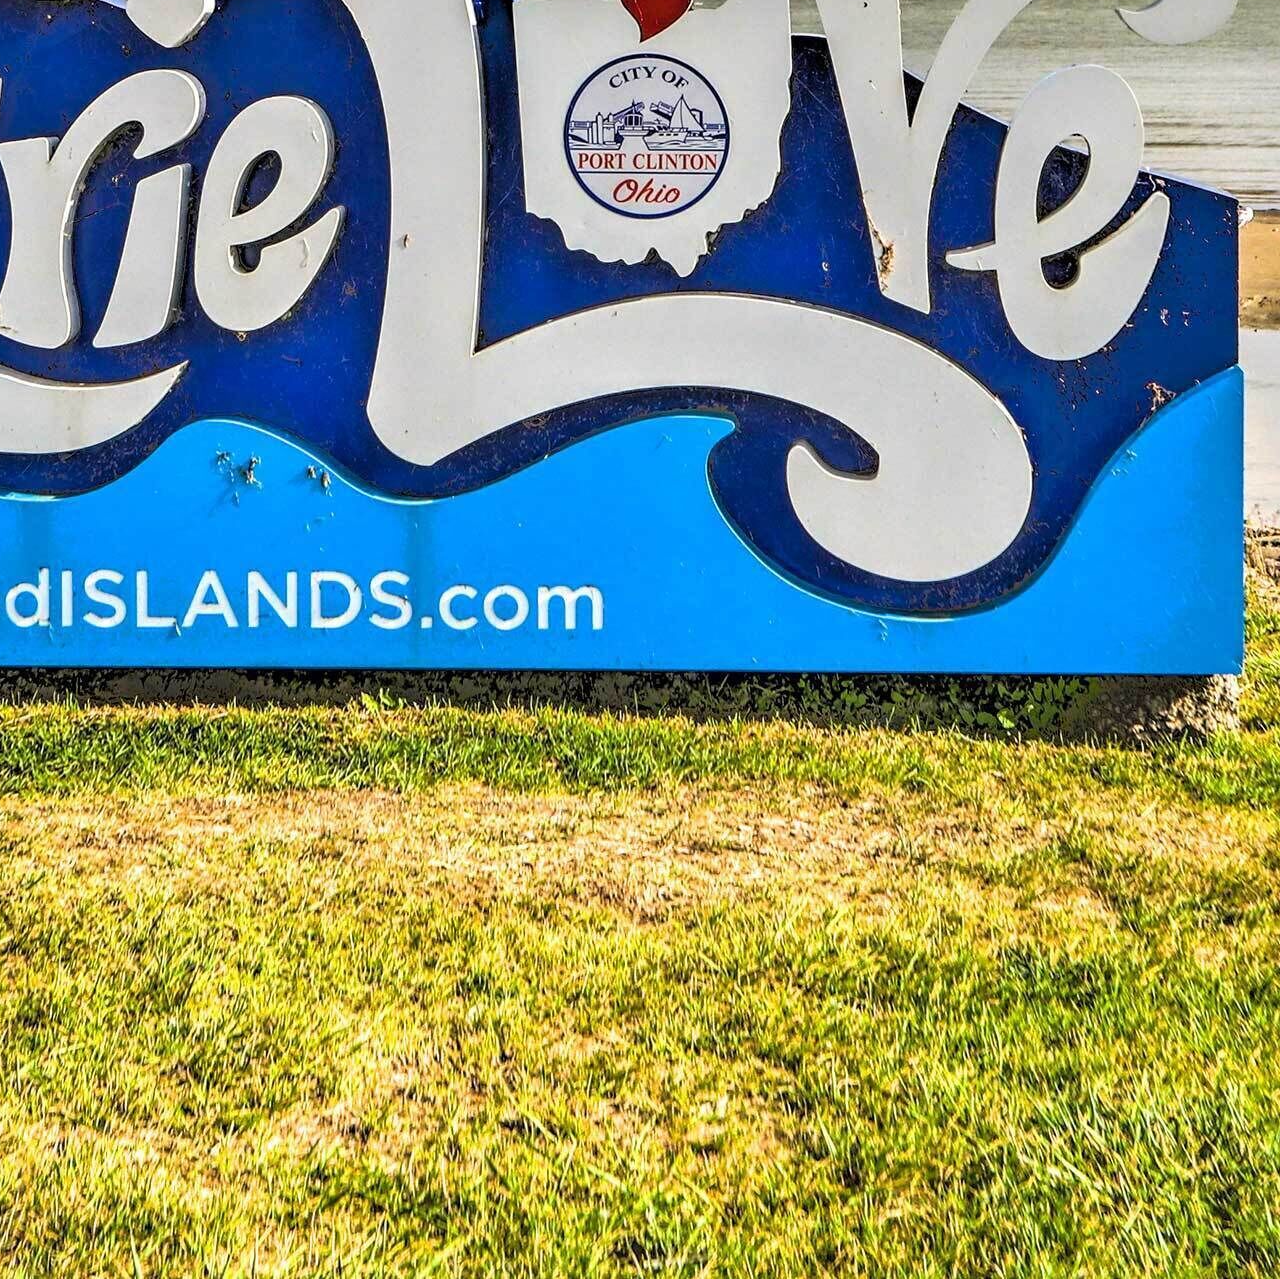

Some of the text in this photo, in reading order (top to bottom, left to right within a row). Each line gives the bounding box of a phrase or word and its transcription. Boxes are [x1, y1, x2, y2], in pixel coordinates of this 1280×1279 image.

[608, 65, 690, 90] CITY OF
[577, 152, 718, 171] PORT CLINTON
[612, 178, 681, 204] Ohio
